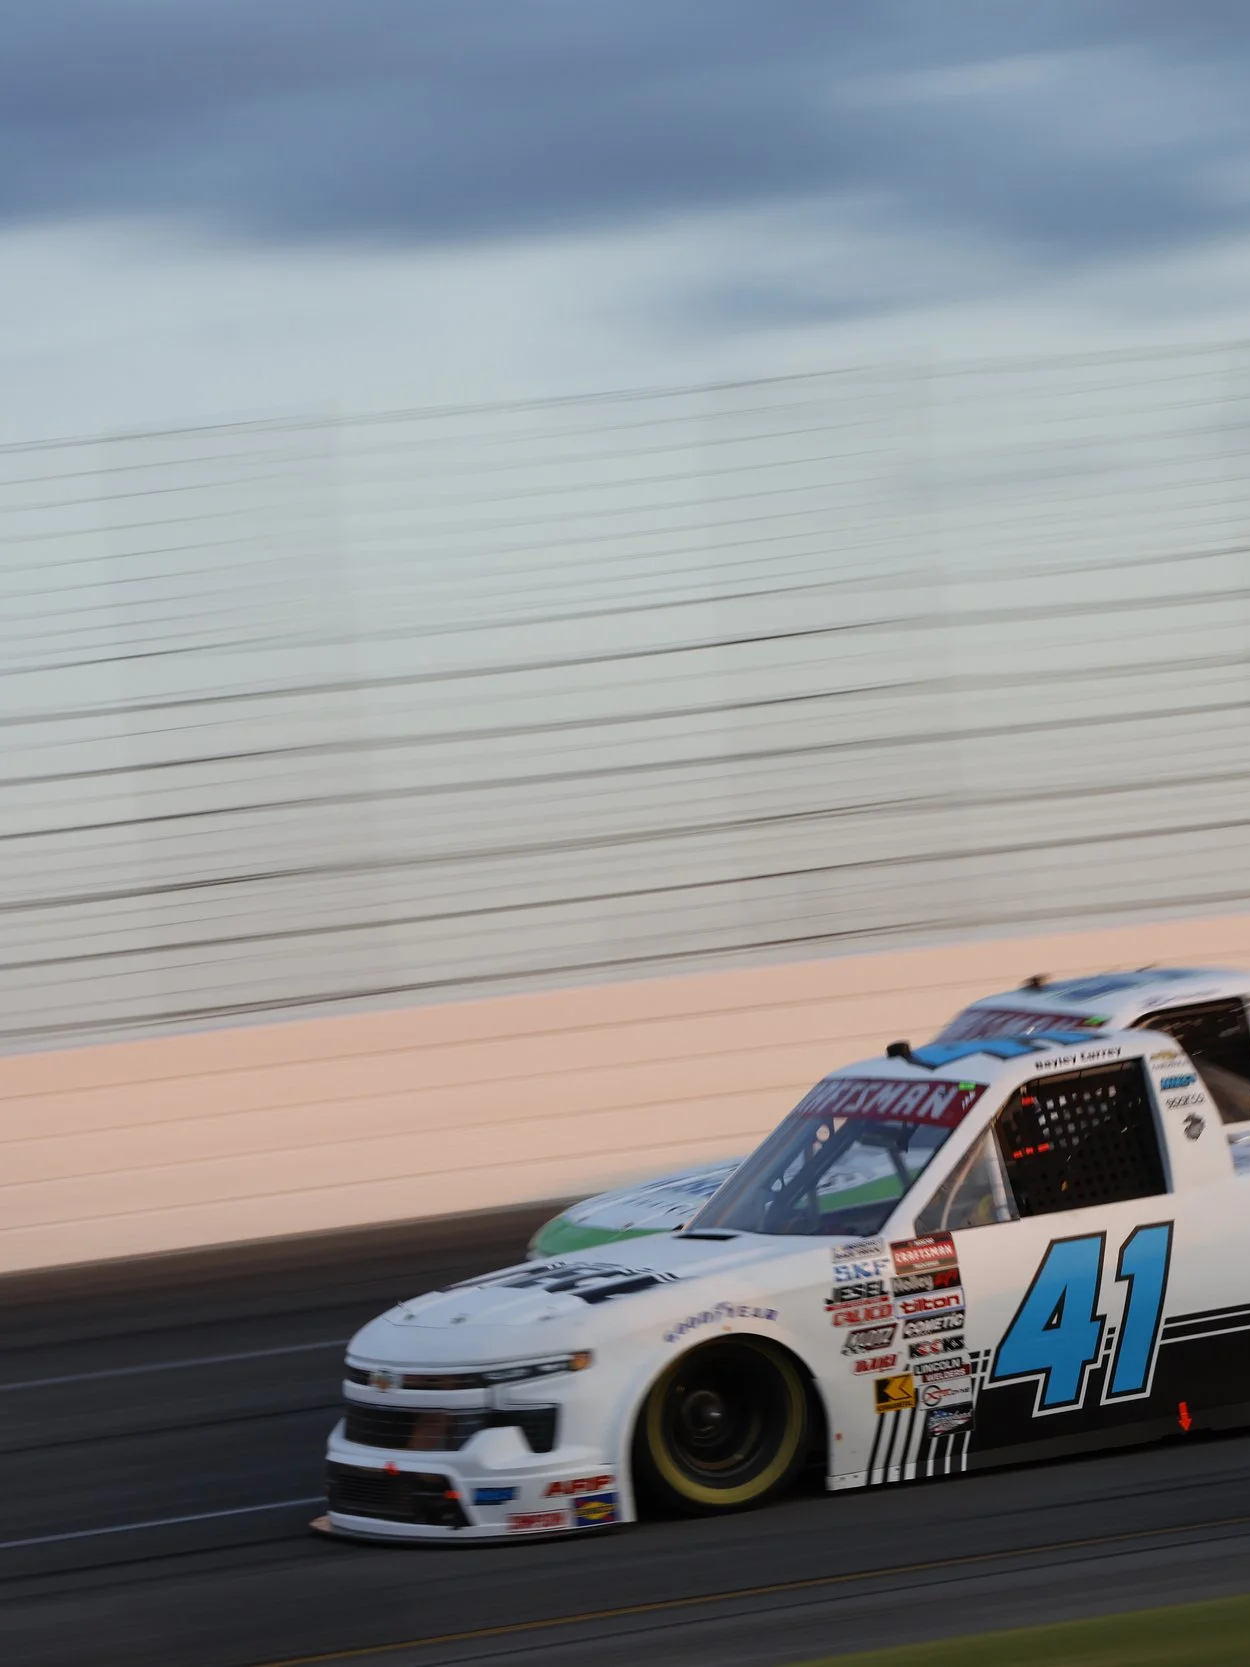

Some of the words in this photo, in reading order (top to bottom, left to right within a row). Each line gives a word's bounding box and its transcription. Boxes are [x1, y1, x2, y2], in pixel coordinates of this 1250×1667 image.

[833, 1257, 889, 1282] SKF
[901, 1294, 961, 1315] tilton
[903, 1311, 965, 1338] COMETIC
[984, 1219, 1176, 1418] 41
[913, 1357, 962, 1376] LINCOLN
